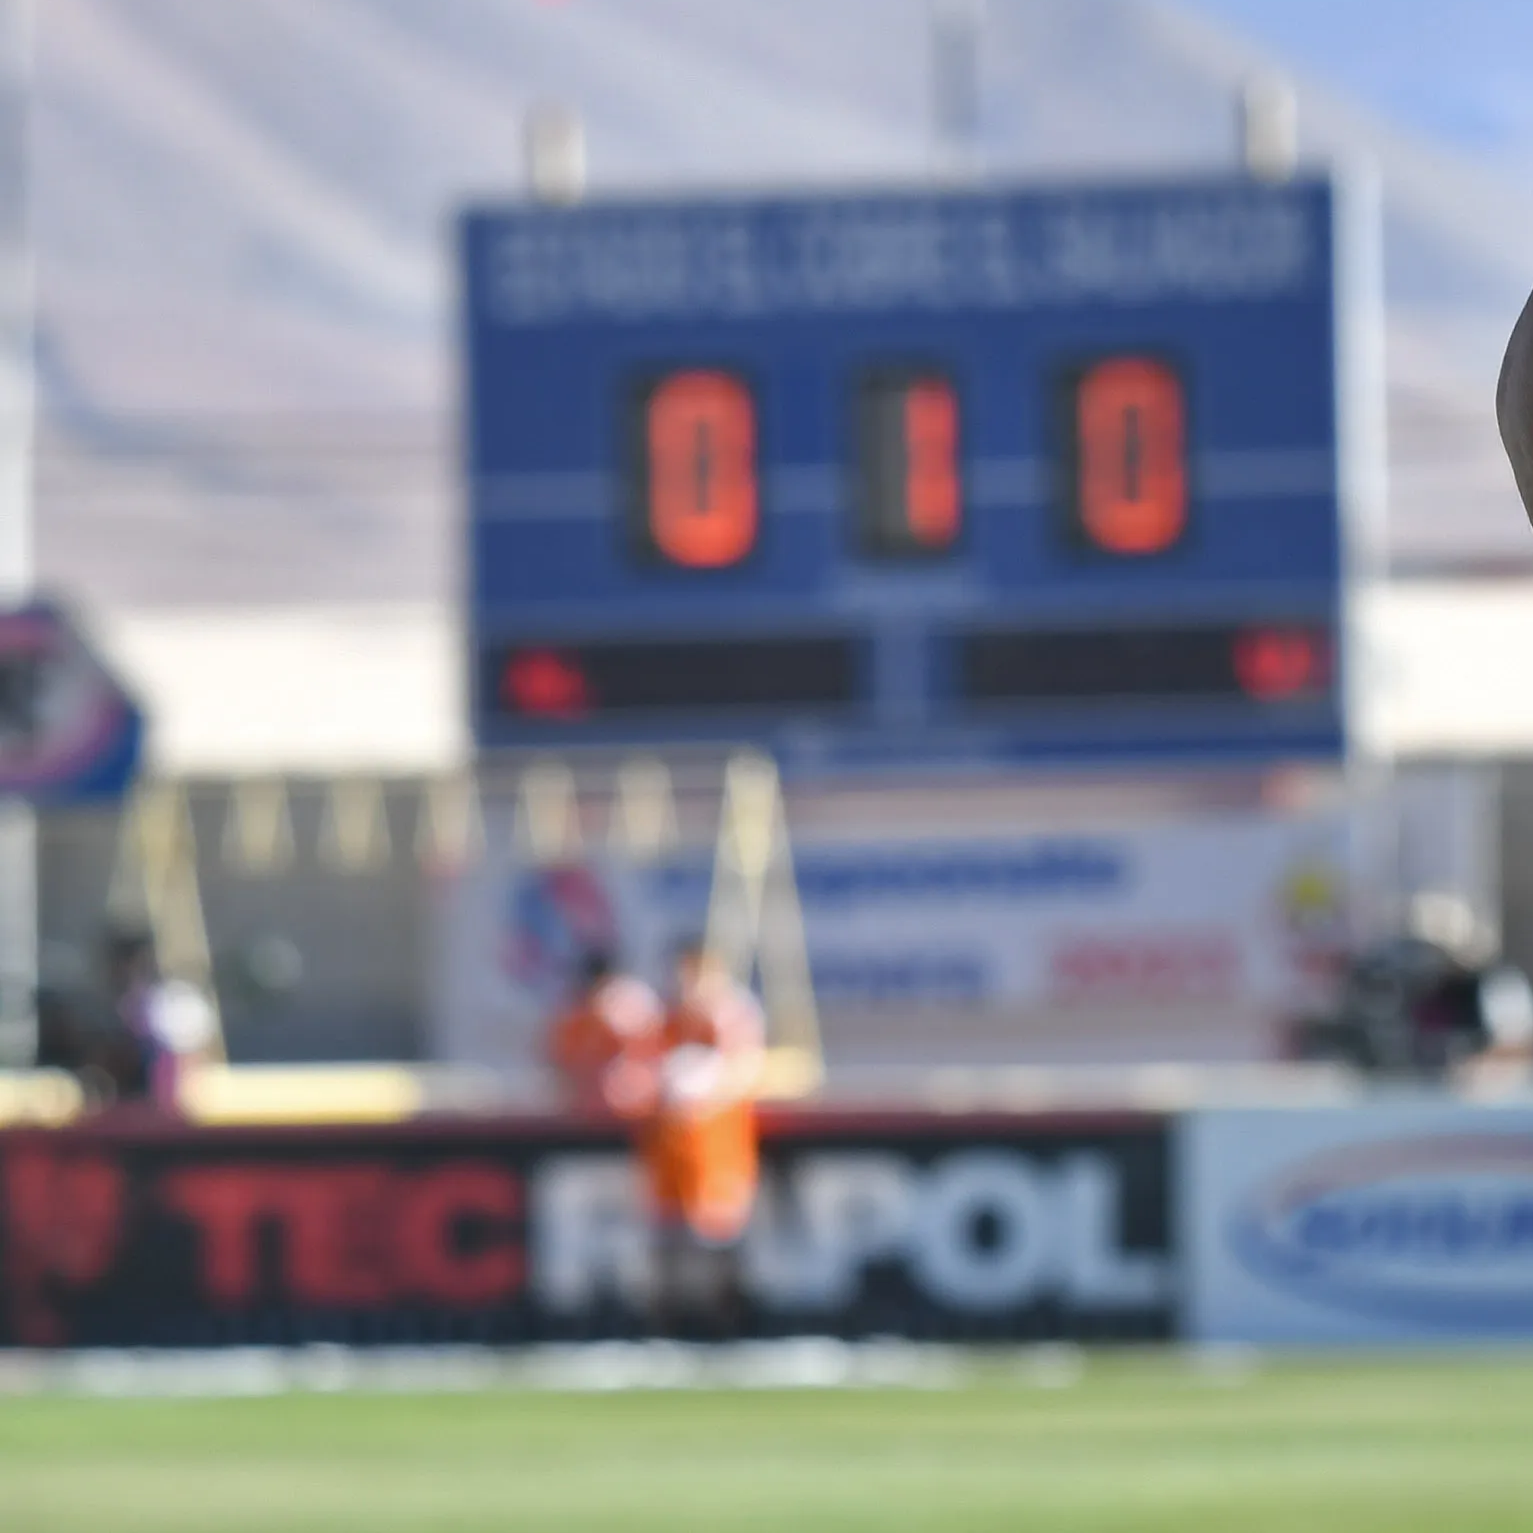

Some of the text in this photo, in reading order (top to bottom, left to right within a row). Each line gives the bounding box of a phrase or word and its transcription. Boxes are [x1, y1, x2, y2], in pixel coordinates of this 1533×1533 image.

[648, 356, 1190, 567] 0 1 0
